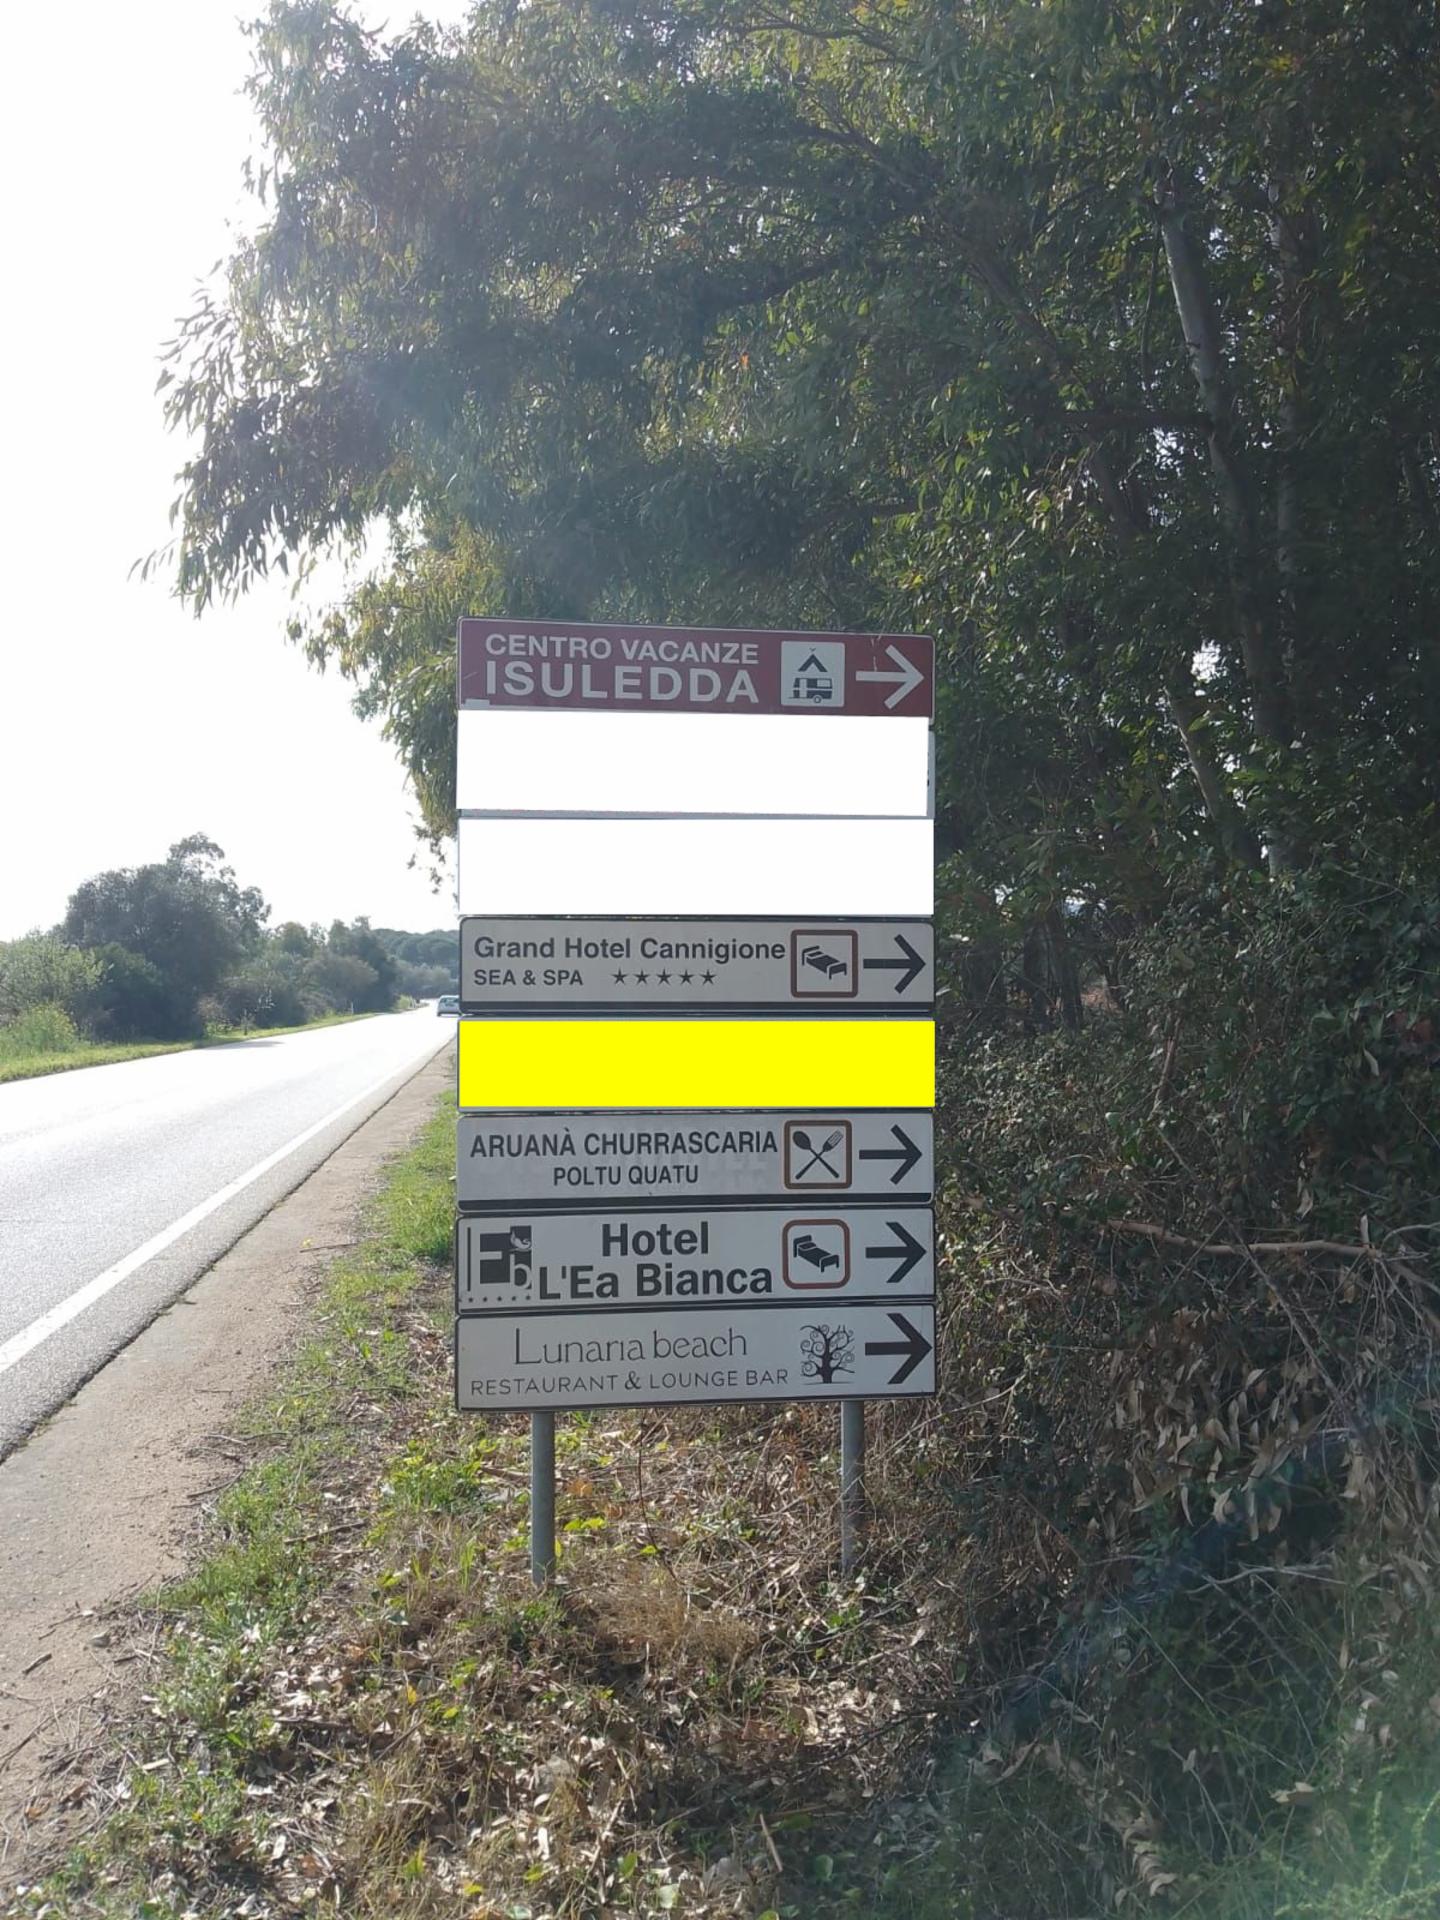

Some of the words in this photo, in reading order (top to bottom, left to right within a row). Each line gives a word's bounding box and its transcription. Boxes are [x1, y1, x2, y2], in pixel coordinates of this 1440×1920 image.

[485, 633, 612, 659] CENTRO
[620, 638, 759, 665] VACANZE
[485, 661, 759, 703] ISULEDDA
[473, 936, 555, 959] Grand
[564, 937, 631, 960] Hotel
[640, 938, 785, 965] Cannigione
[473, 969, 518, 986] SEA
[522, 969, 537, 986] &
[542, 969, 584, 986] SPA
[470, 1128, 576, 1159] ARUANÀ
[584, 1131, 778, 1157] CHURRASCARIA
[553, 1166, 622, 1186] POLTU
[628, 1165, 699, 1185] QUATU
[601, 1222, 709, 1257] Hotel
[539, 1265, 620, 1300] L'Ea
[636, 1262, 773, 1297] Bianca
[514, 1327, 645, 1366] Lunaria
[653, 1327, 748, 1359] beach
[471, 1374, 620, 1396] RESTAURANT
[624, 1371, 641, 1390] &
[649, 1370, 738, 1389] LOUNGE
[745, 1369, 788, 1386] BAR
